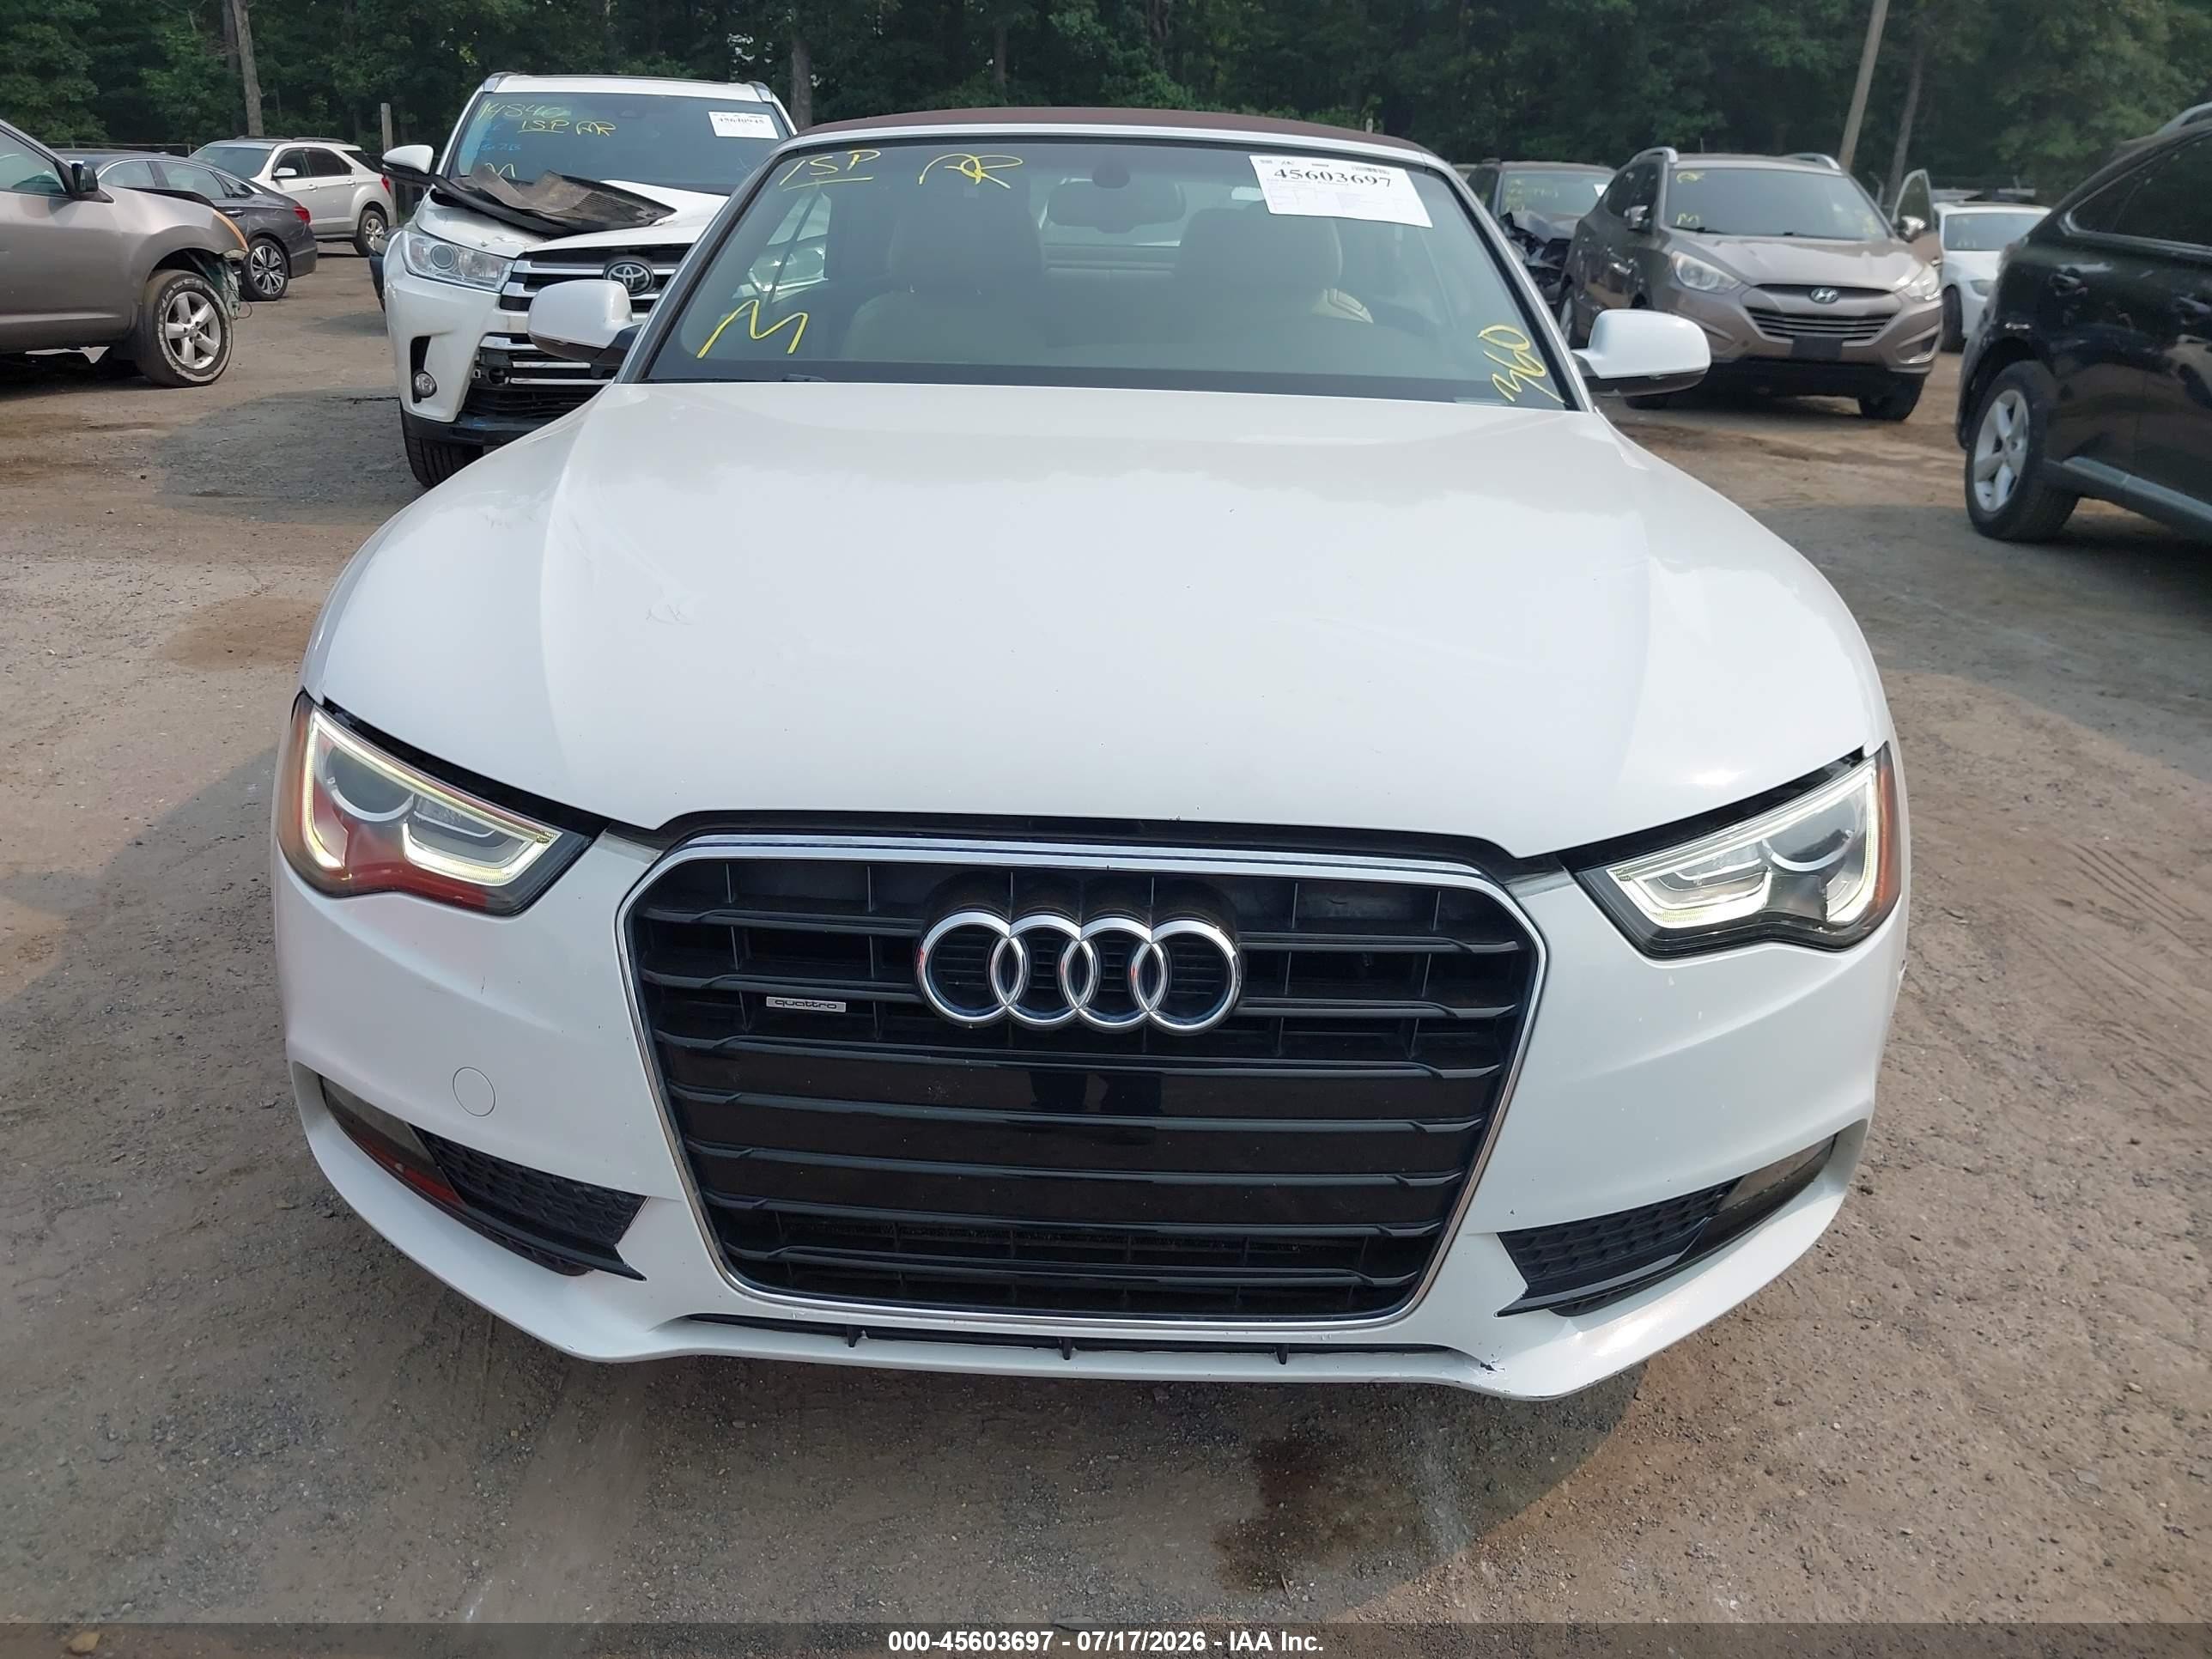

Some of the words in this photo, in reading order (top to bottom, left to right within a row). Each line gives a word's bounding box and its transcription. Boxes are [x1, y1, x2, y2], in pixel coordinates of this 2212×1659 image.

[1273, 168, 1391, 187] 45603697
[696, 299, 809, 359] M
[775, 1000, 837, 1010] quattro
